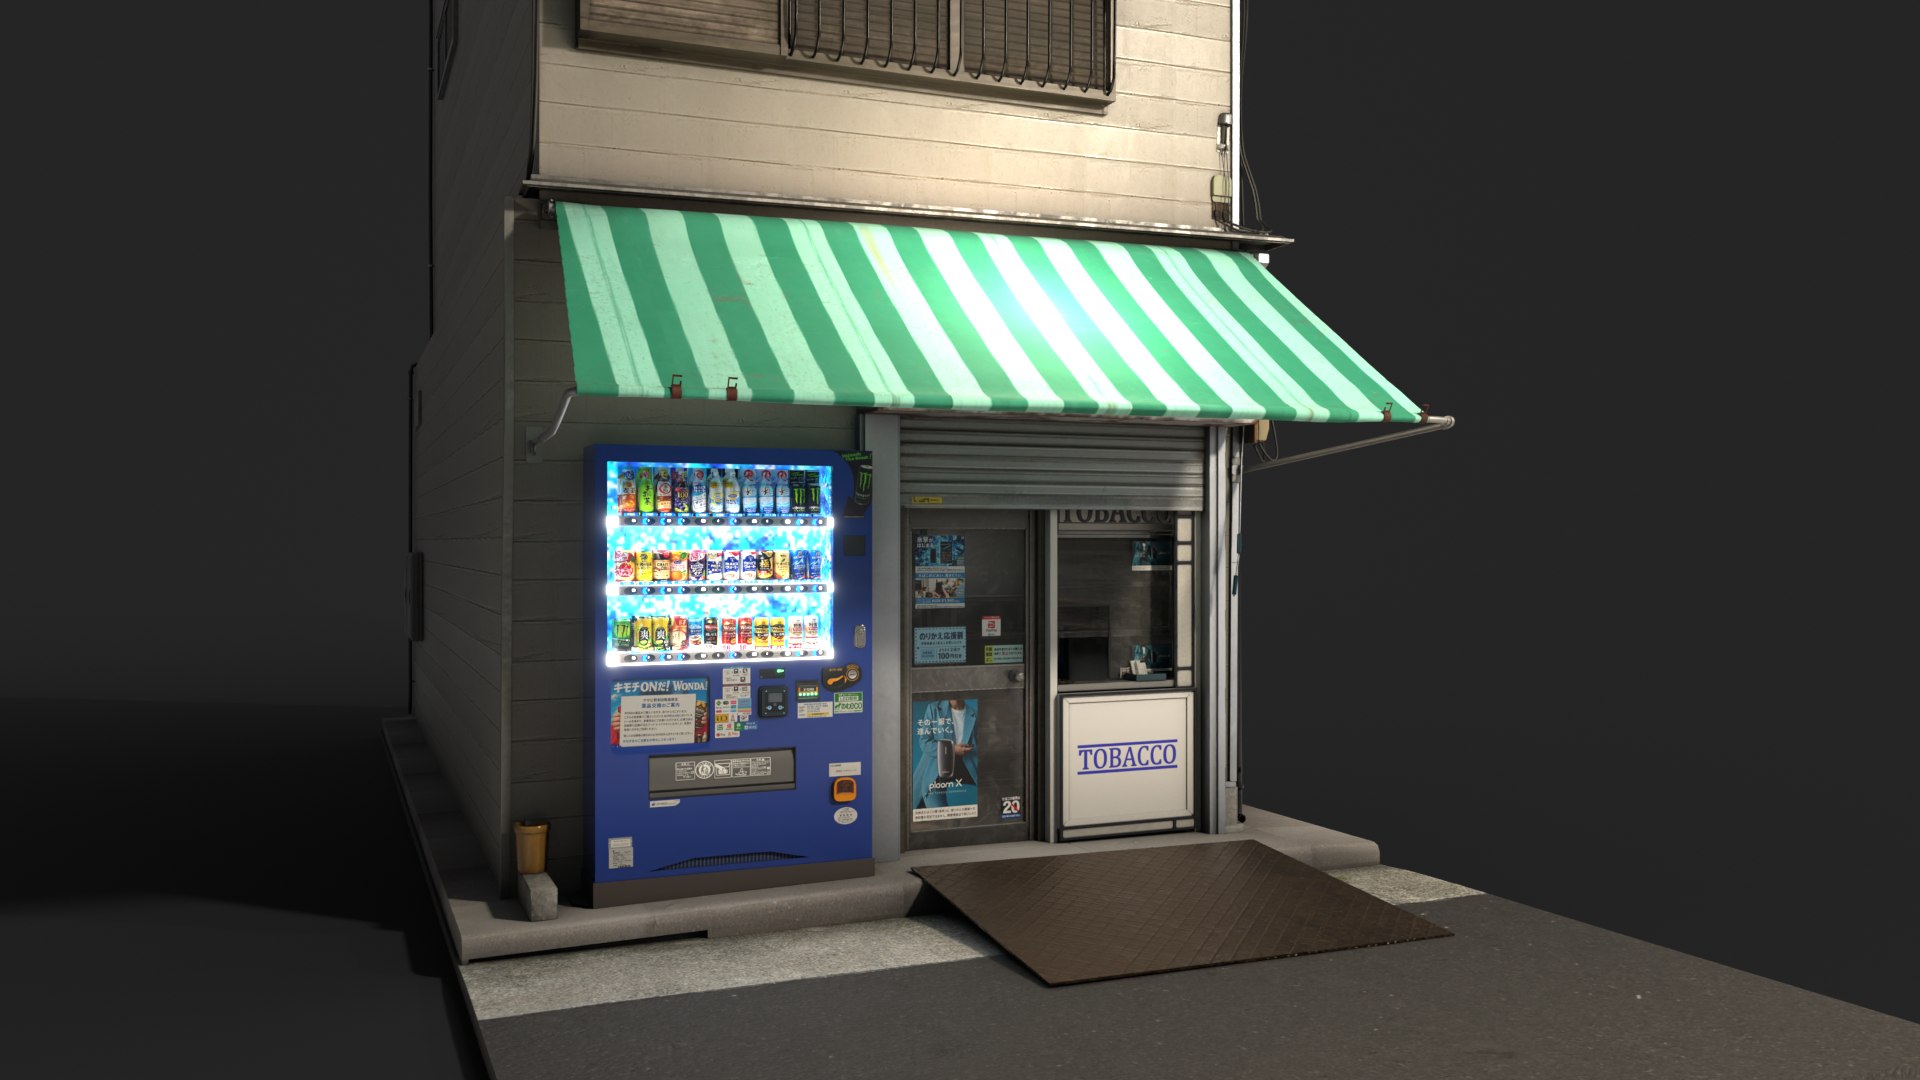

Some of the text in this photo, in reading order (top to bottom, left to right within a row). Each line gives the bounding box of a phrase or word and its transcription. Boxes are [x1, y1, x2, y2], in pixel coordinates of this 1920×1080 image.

[1078, 744, 1177, 770] TOBACCO
[929, 778, 963, 791] ploom X
